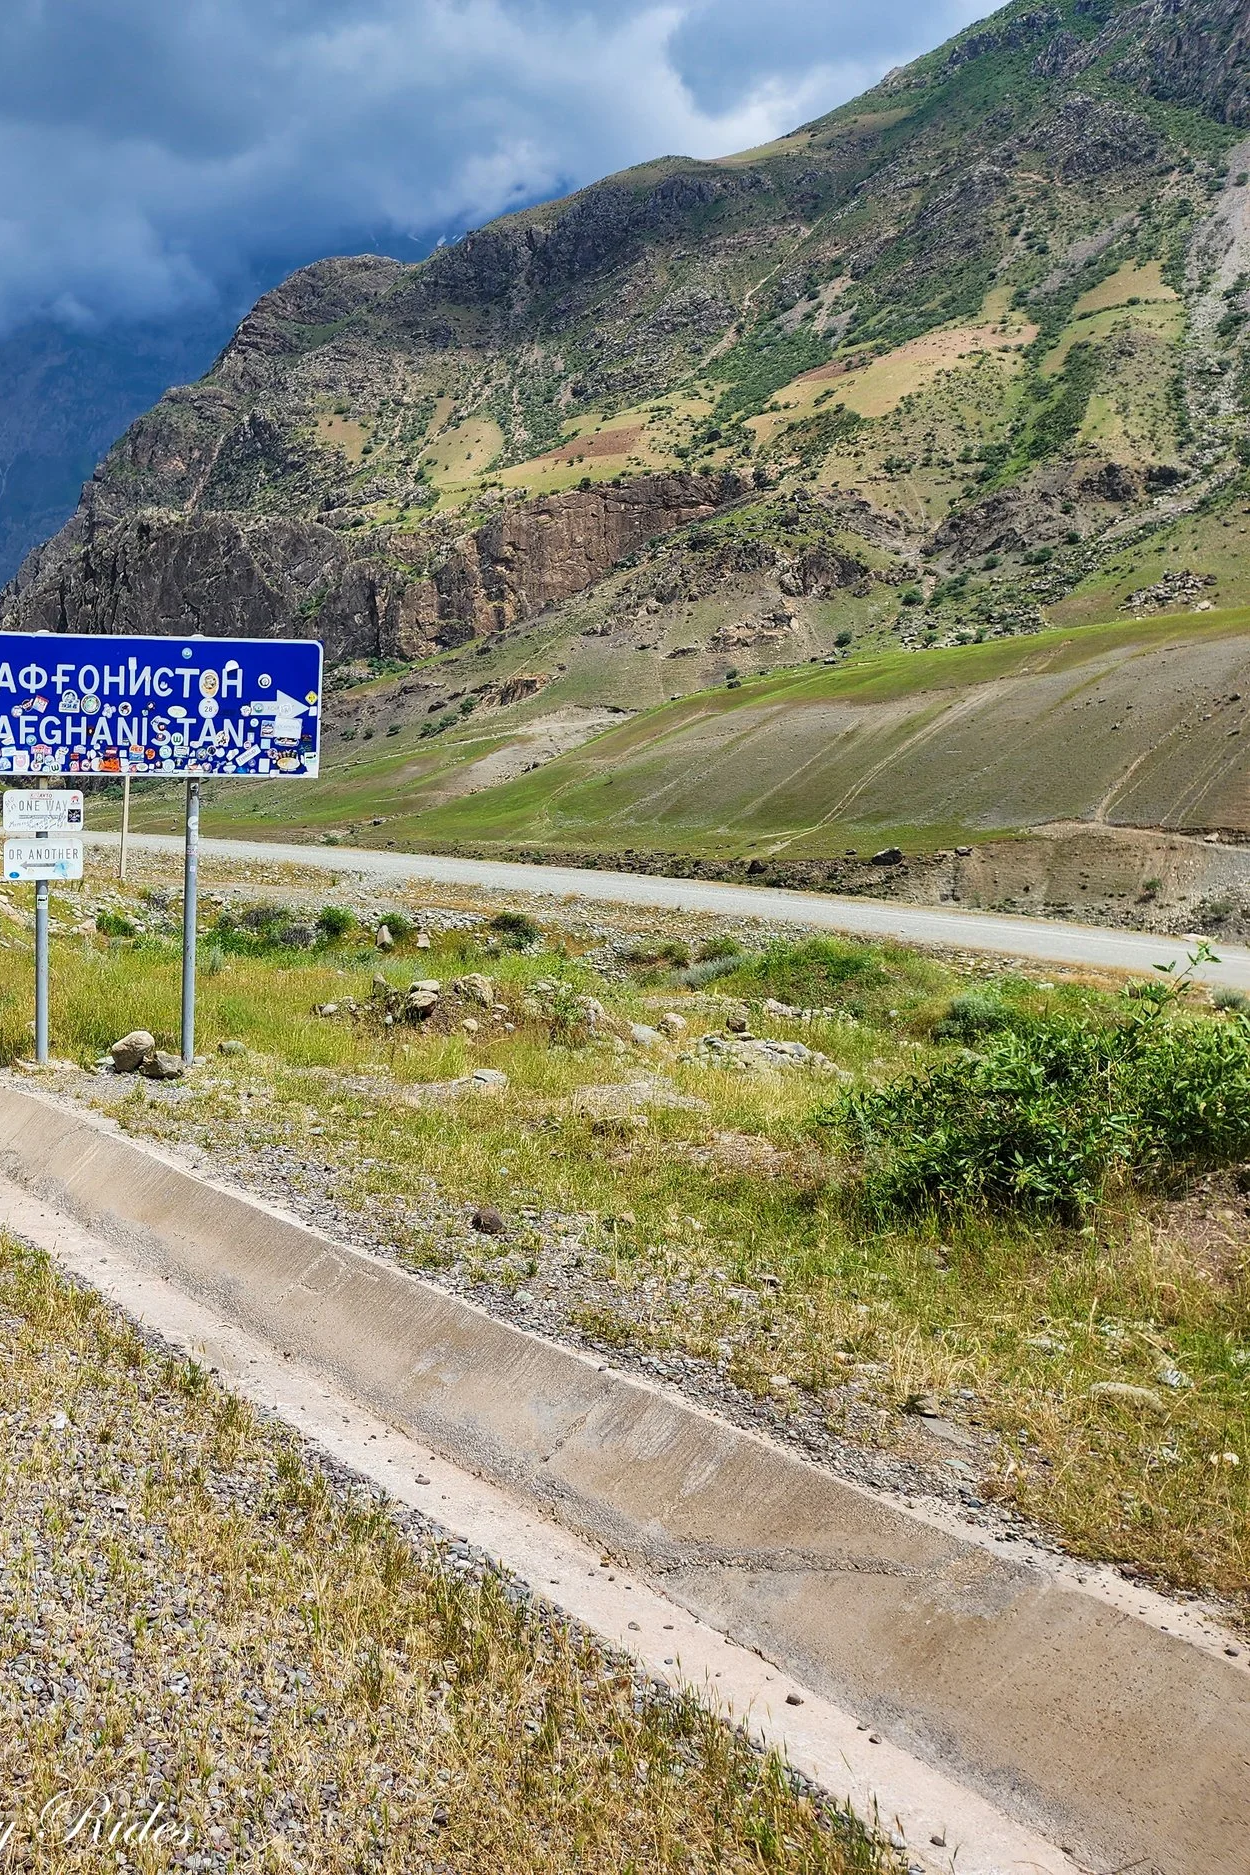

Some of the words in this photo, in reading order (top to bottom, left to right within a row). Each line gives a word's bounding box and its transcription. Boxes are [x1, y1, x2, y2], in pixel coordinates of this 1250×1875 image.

[18, 800, 40, 812] ONE
[45, 800, 68, 812] WAY
[8, 848, 23, 860] OR
[28, 848, 79, 860] ANOTHER
